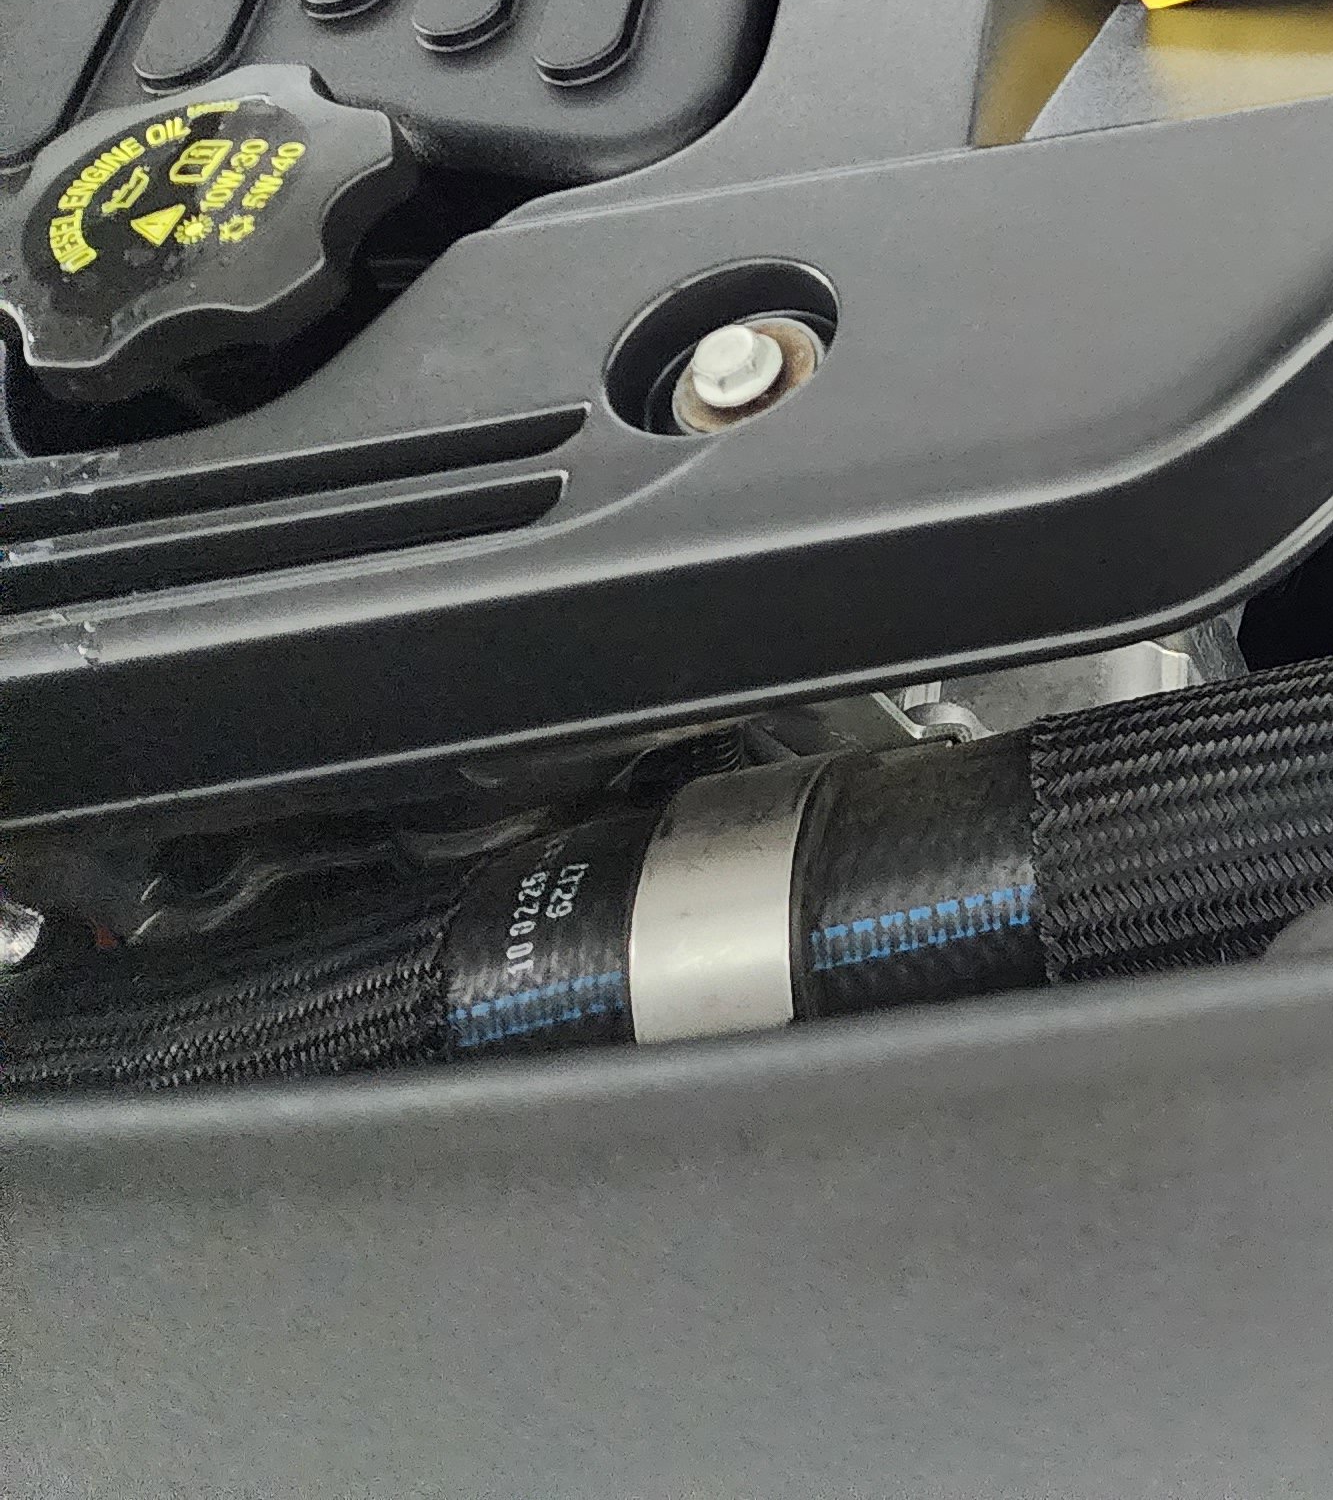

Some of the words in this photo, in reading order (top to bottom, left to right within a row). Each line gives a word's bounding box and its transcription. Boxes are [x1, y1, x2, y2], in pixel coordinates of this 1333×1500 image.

[58, 136, 145, 210] ENGINE
[146, 116, 192, 147] OIL
[200, 138, 269, 212] 10W-30
